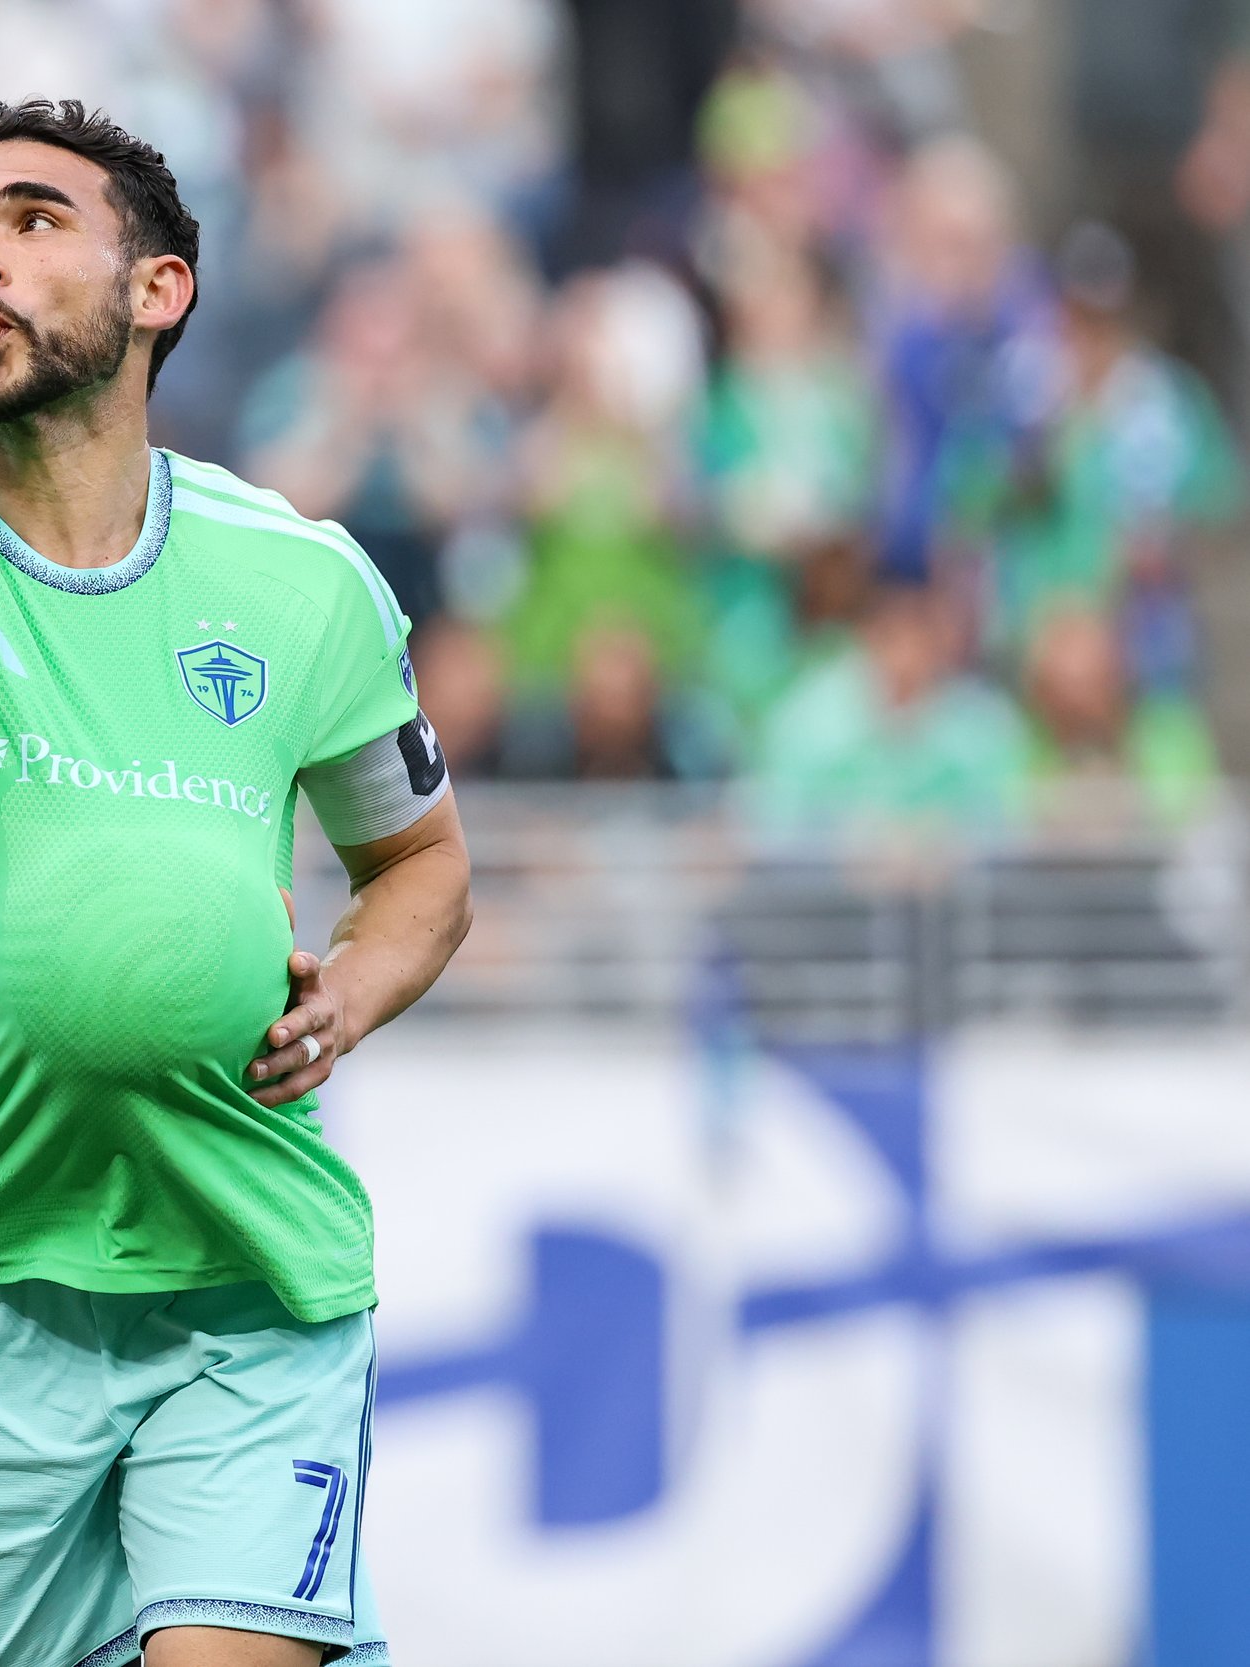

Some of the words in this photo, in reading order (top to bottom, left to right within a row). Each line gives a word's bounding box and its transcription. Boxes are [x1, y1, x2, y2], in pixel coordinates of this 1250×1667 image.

[196, 684, 209, 693] 19
[240, 689, 254, 698] 74
[14, 732, 271, 825] Providence
[292, 1459, 349, 1602] 7
